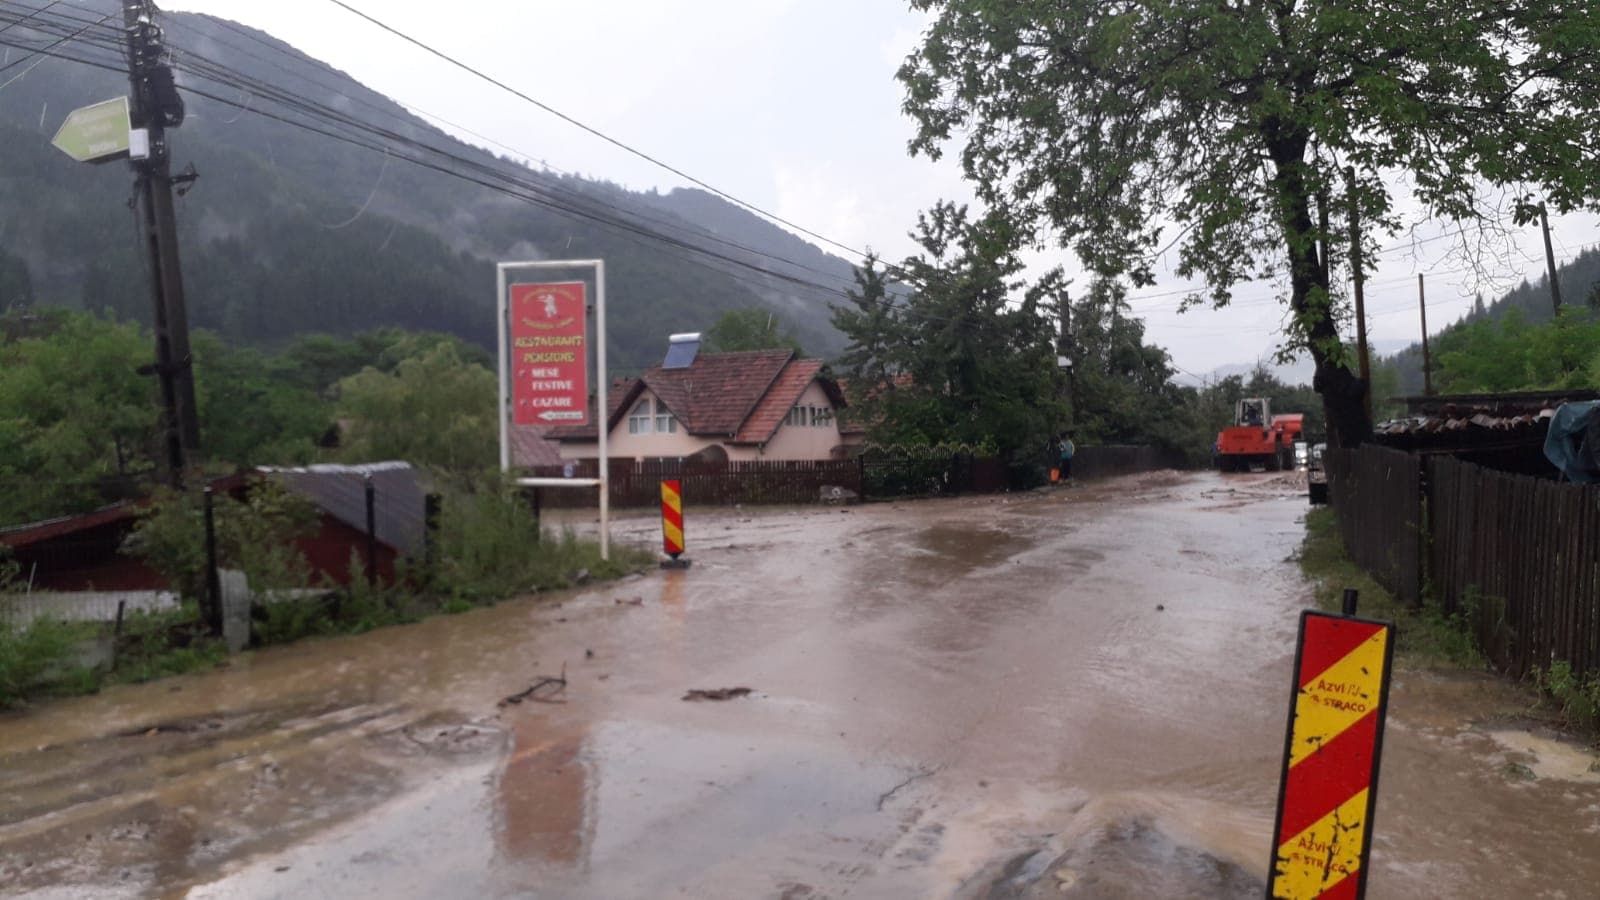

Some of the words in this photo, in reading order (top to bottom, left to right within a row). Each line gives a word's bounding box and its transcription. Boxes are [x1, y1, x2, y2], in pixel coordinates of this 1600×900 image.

[515, 336, 583, 347] RESTAURANT
[532, 367, 559, 378] MESE
[532, 380, 573, 391] FESTIVE
[532, 396, 572, 408] CAZARE
[1323, 697, 1366, 713] STRACO
[1304, 856, 1346, 873] STRCO
